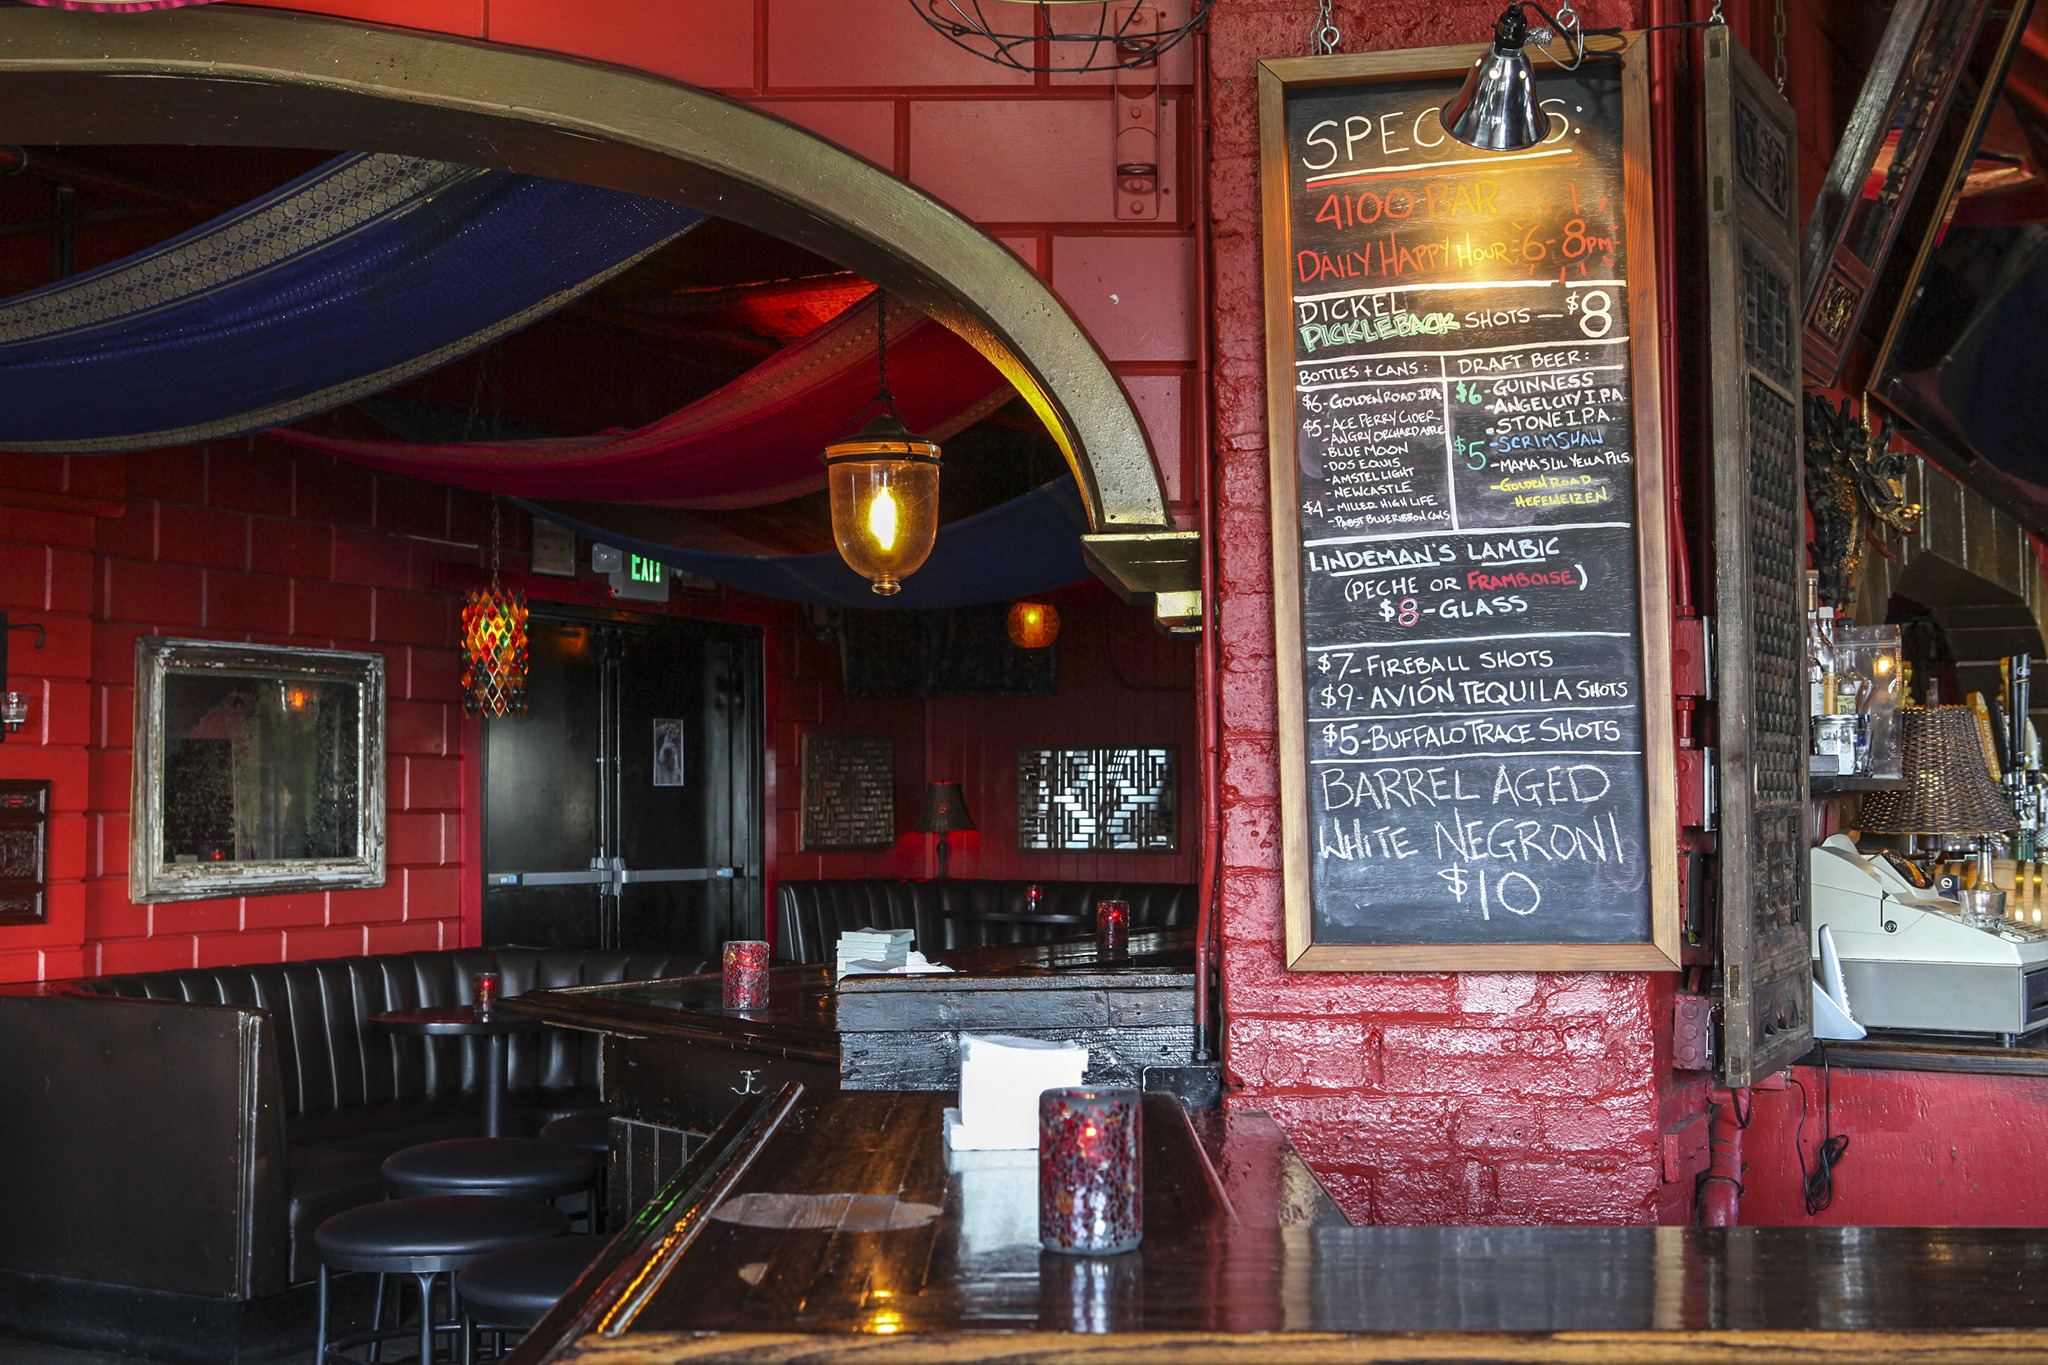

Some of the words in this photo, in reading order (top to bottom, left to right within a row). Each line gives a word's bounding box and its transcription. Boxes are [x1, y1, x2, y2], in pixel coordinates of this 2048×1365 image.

[1302, 98, 1583, 170] SPECS:
[1315, 188, 1416, 230] 4100
[1424, 180, 1499, 219] BAR
[1297, 242, 1371, 283] DAILY
[1379, 232, 1450, 276] HAPPY
[1300, 292, 1407, 325] DICKEL
[1300, 312, 1461, 352] PICKLEBACK
[1465, 308, 1531, 329] SHOTS
[1565, 290, 1613, 339] $8
[1299, 366, 1360, 386] BOTTLES
[1457, 354, 1524, 375] DRAFT
[1492, 372, 1595, 397] GUINNESS
[1329, 388, 1382, 409] GOLDEN
[1383, 391, 1415, 402] ROAD
[1418, 388, 1442, 401] IPA
[1331, 418, 1358, 433] ACE
[1359, 410, 1397, 428] PERRY
[1399, 410, 1441, 423] CIDER
[1373, 427, 1419, 442] ORCHARD
[1364, 442, 1409, 457] MOON
[1453, 435, 1487, 471] $5
[1551, 457, 1568, 469] LIL
[1569, 453, 1604, 468] YELLA
[1605, 451, 1630, 465] PILS
[1360, 457, 1401, 469] EQUIS
[1381, 467, 1415, 480] LIGHT
[1550, 475, 1592, 487] ROAD
[1337, 501, 1378, 512] MILLER
[1380, 498, 1407, 509] HIGH
[1410, 495, 1438, 507] LIFE
[1514, 486, 1608, 508] HEFEWEIZEN
[1366, 516, 1393, 524] BLUE
[1393, 510, 1426, 522] RIBBON
[1309, 542, 1456, 572] LINDEMAN'S
[1468, 537, 1560, 560] LAMBIC
[1430, 577, 1461, 591] OR
[1438, 595, 1529, 619] GLASS
[1366, 654, 1470, 678] FIREBALL
[1480, 650, 1554, 669] SHOTS
[1458, 678, 1573, 707] TEQUILA
[1576, 679, 1629, 698] SHOTS
[1371, 725, 1466, 752] BUFFALO
[1464, 718, 1536, 746] TRACE
[1539, 717, 1621, 742] SHOTS
[1320, 766, 1480, 811] BARREL
[1492, 763, 1611, 808] AGED
[1319, 817, 1419, 860] WHITE
[1434, 807, 1625, 864] NEGRONI
[1437, 861, 1541, 921] $10
